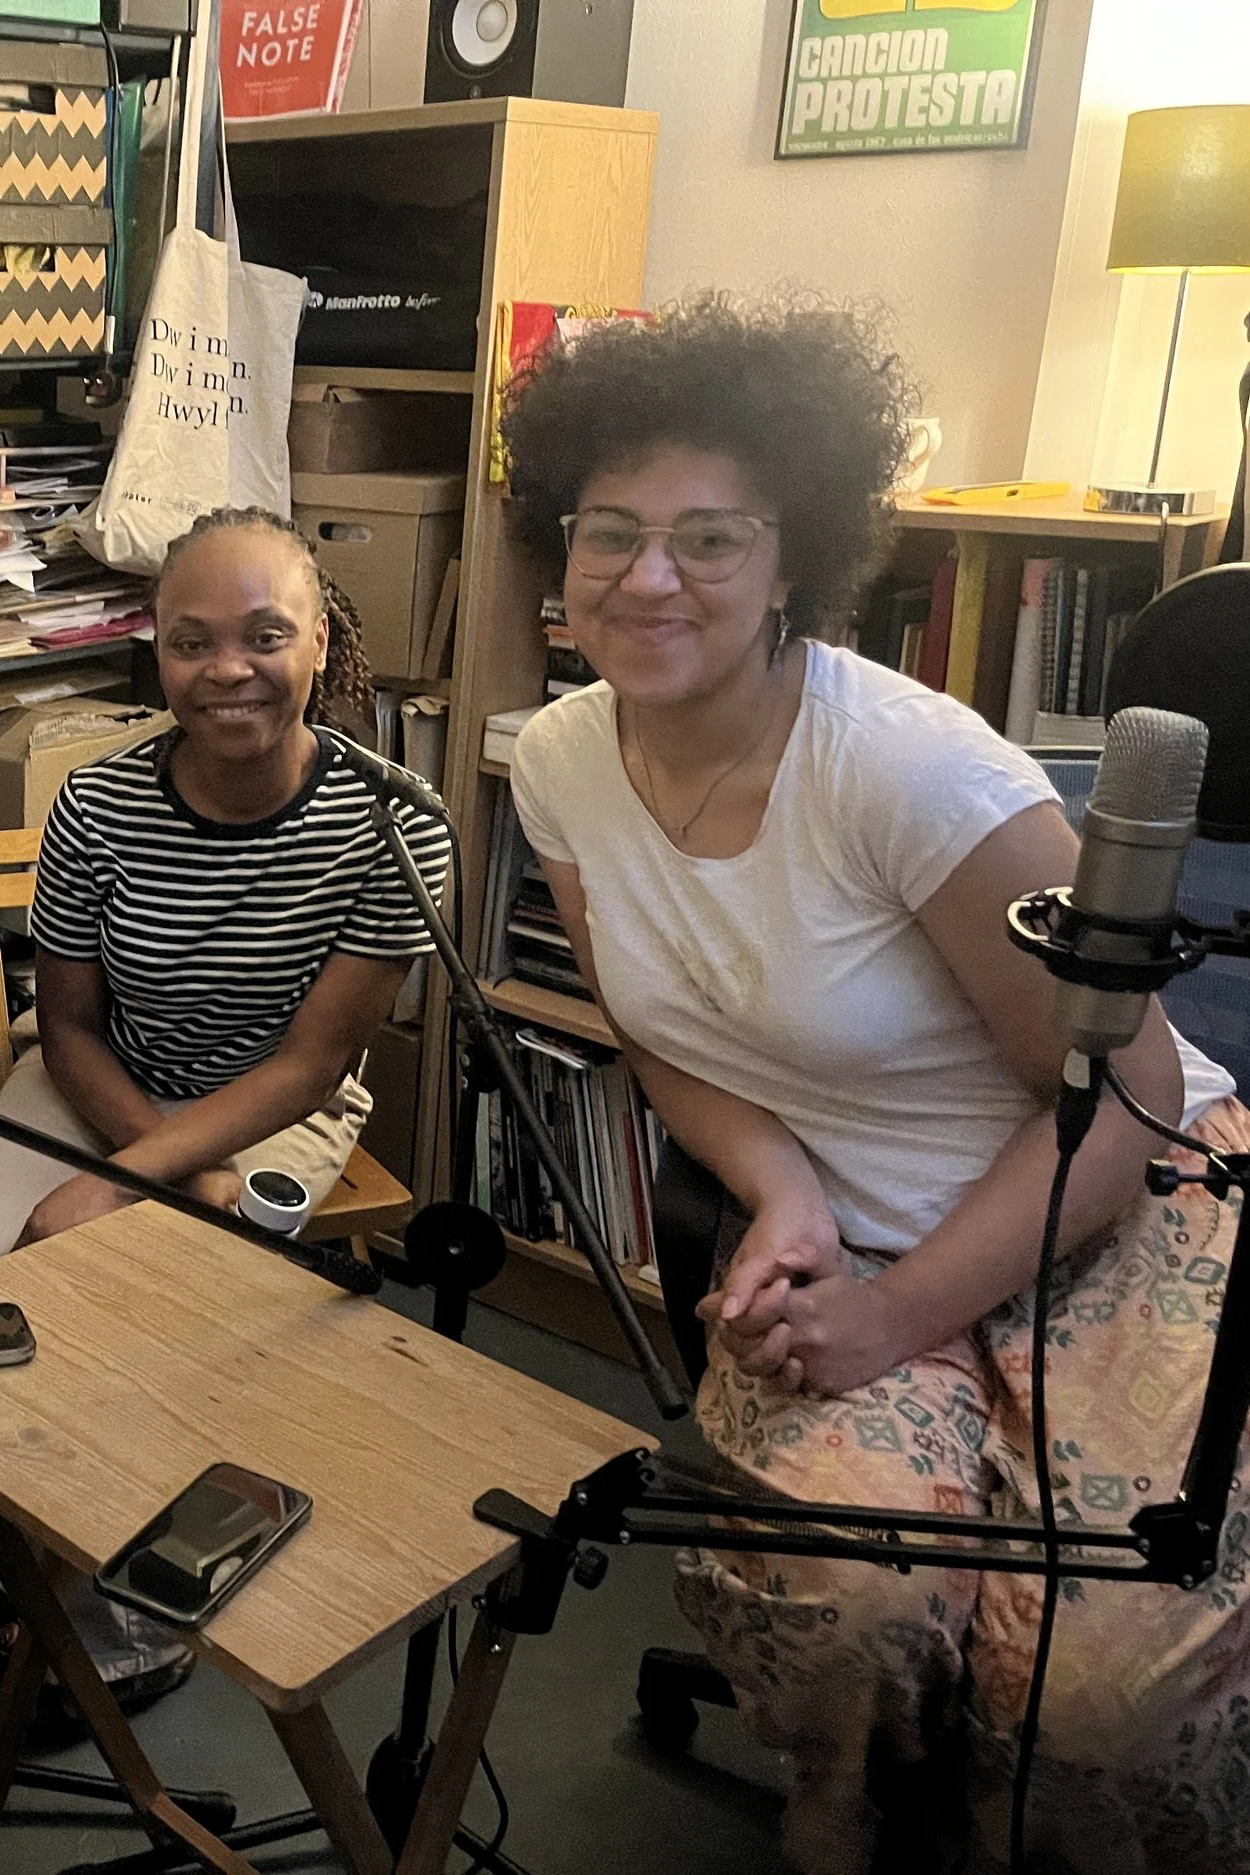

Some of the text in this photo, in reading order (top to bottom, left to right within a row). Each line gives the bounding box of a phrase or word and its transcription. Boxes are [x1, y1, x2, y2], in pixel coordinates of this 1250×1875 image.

[241, 4, 320, 36] FALSE
[236, 36, 314, 68] NOTE
[799, 28, 948, 78] CANCION
[792, 69, 1017, 135] PROTESTA
[324, 294, 401, 310] Manfrotto
[150, 318, 182, 347] Dw
[151, 352, 178, 384] Dw
[157, 392, 218, 430] Hwyl
